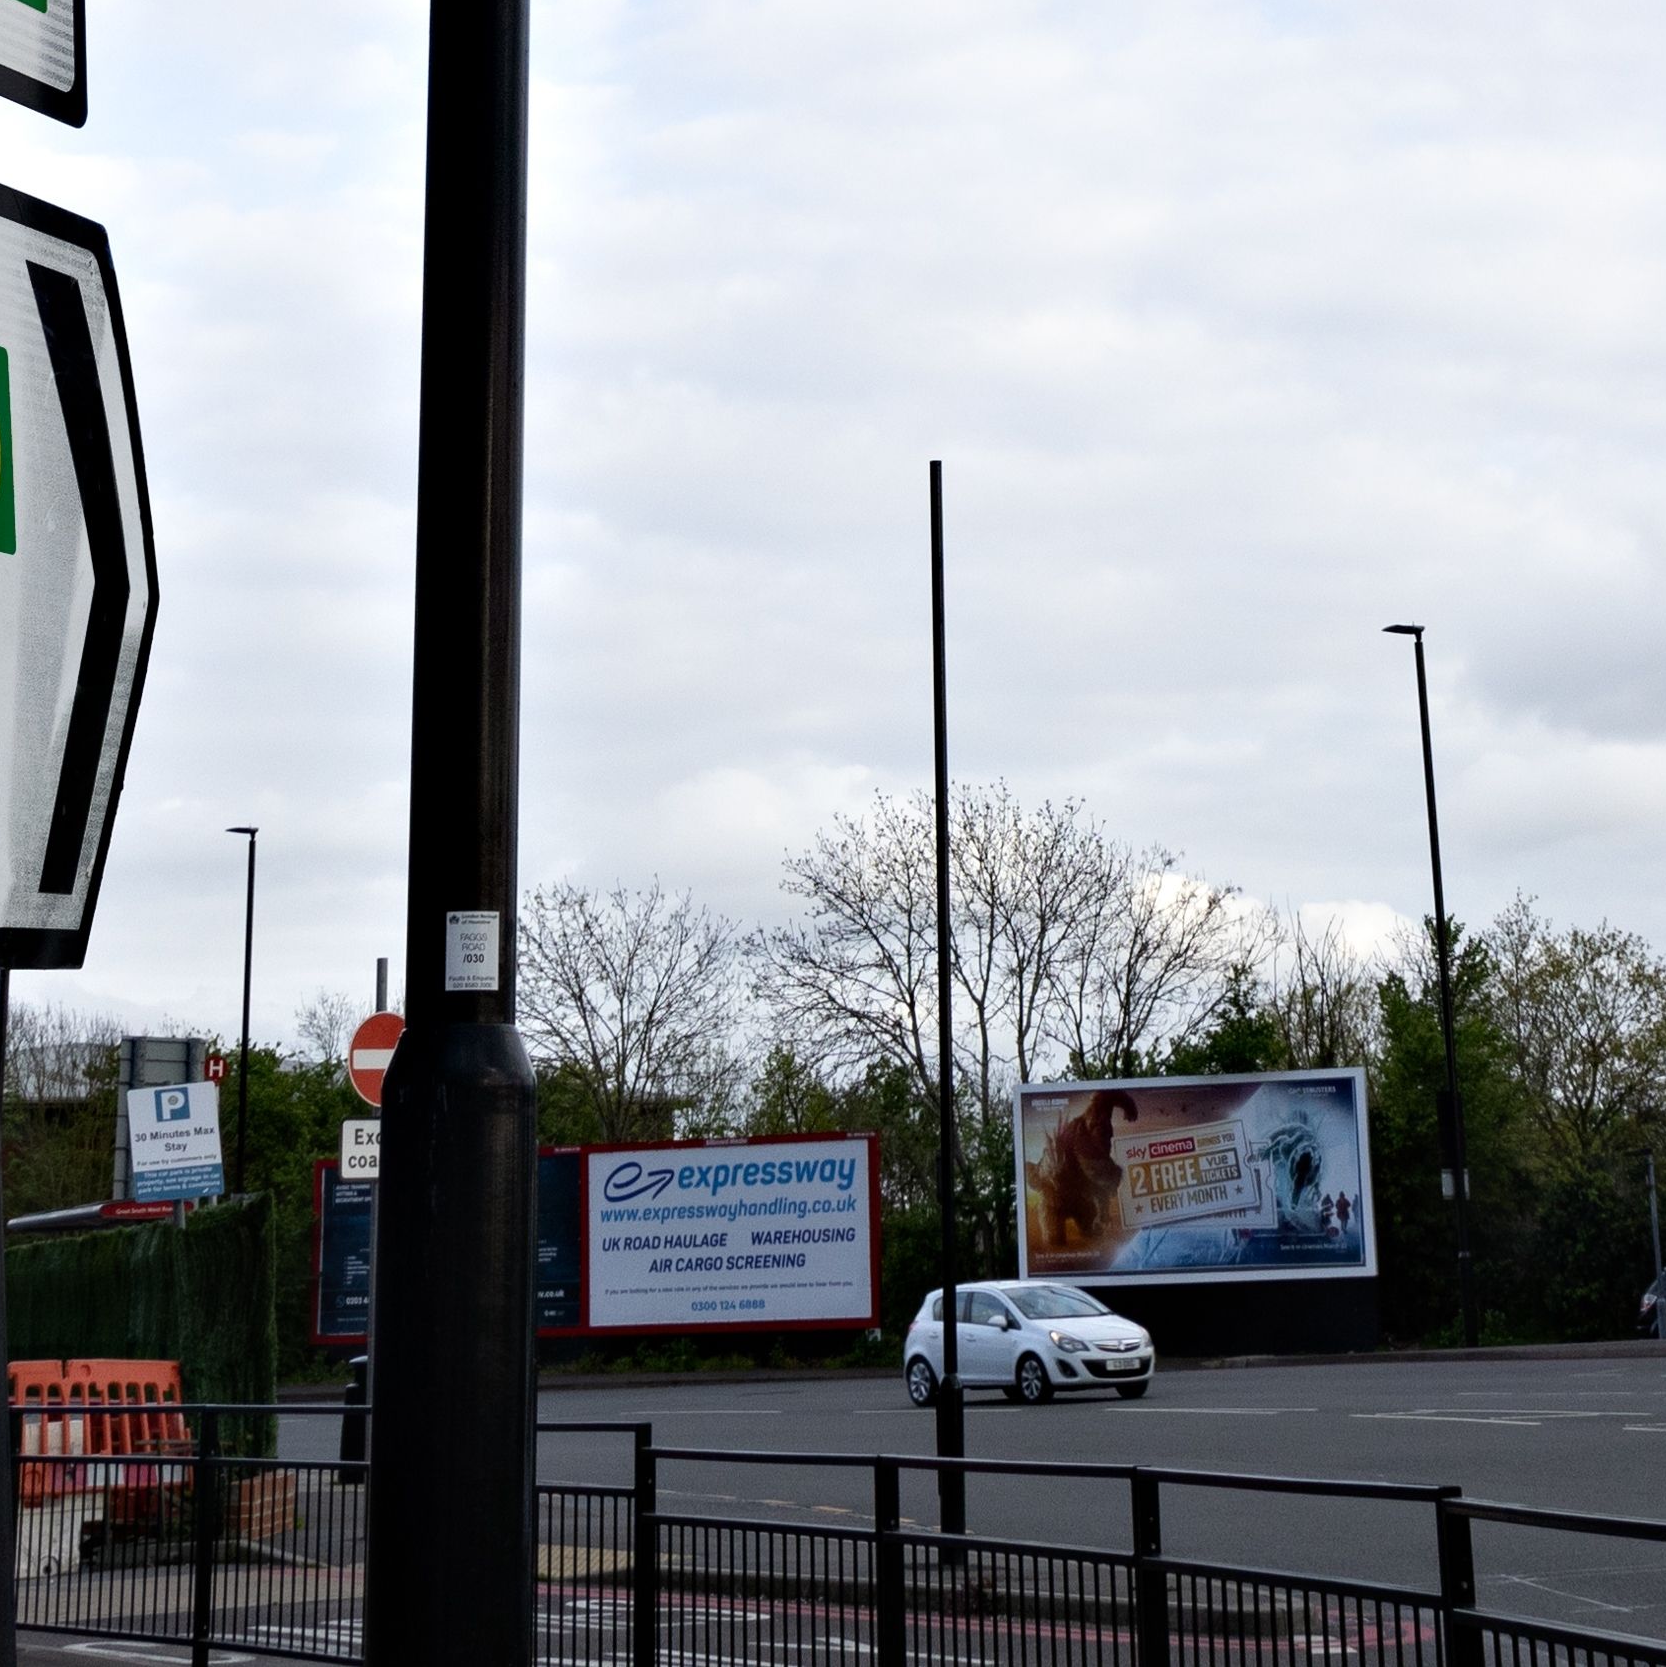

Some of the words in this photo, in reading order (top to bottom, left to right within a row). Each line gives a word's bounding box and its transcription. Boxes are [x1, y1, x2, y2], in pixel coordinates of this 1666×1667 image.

[460, 933, 487, 941] FAGGS
[462, 943, 485, 951] ROAD
[463, 953, 485, 963] /030
[209, 1059, 224, 1077] H
[161, 1090, 186, 1120] P
[135, 1133, 147, 1142] 30
[150, 1128, 191, 1141] Minutes
[194, 1126, 215, 1136] Max
[354, 1129, 381, 1146] Exc
[1221, 1133, 1235, 1143] YOU
[164, 1142, 188, 1153] Stay
[1125, 1146, 1147, 1159] sky
[1151, 1138, 1194, 1155] cinema
[1206, 1155, 1229, 1167] vue
[677, 1158, 856, 1196] expressway
[1133, 1167, 1148, 1194] 2
[1151, 1158, 1198, 1192] FREE
[1201, 1166, 1238, 1182] TICKETS
[1150, 1193, 1185, 1213] EVERY
[1188, 1186, 1228, 1206] MONTH
[600, 1194, 857, 1224] www.expresswayhandling.co.uk
[602, 1236, 621, 1251] UK
[623, 1235, 661, 1250] ROAD
[663, 1233, 727, 1250] HAULAGE
[751, 1227, 856, 1246] WAREHOUSING
[649, 1258, 672, 1273] AIR
[675, 1256, 723, 1272] CARGO
[726, 1253, 806, 1270] SCREENING
[691, 1301, 717, 1311] 0300
[720, 1300, 736, 1311] 124
[739, 1299, 765, 1310] 6888
